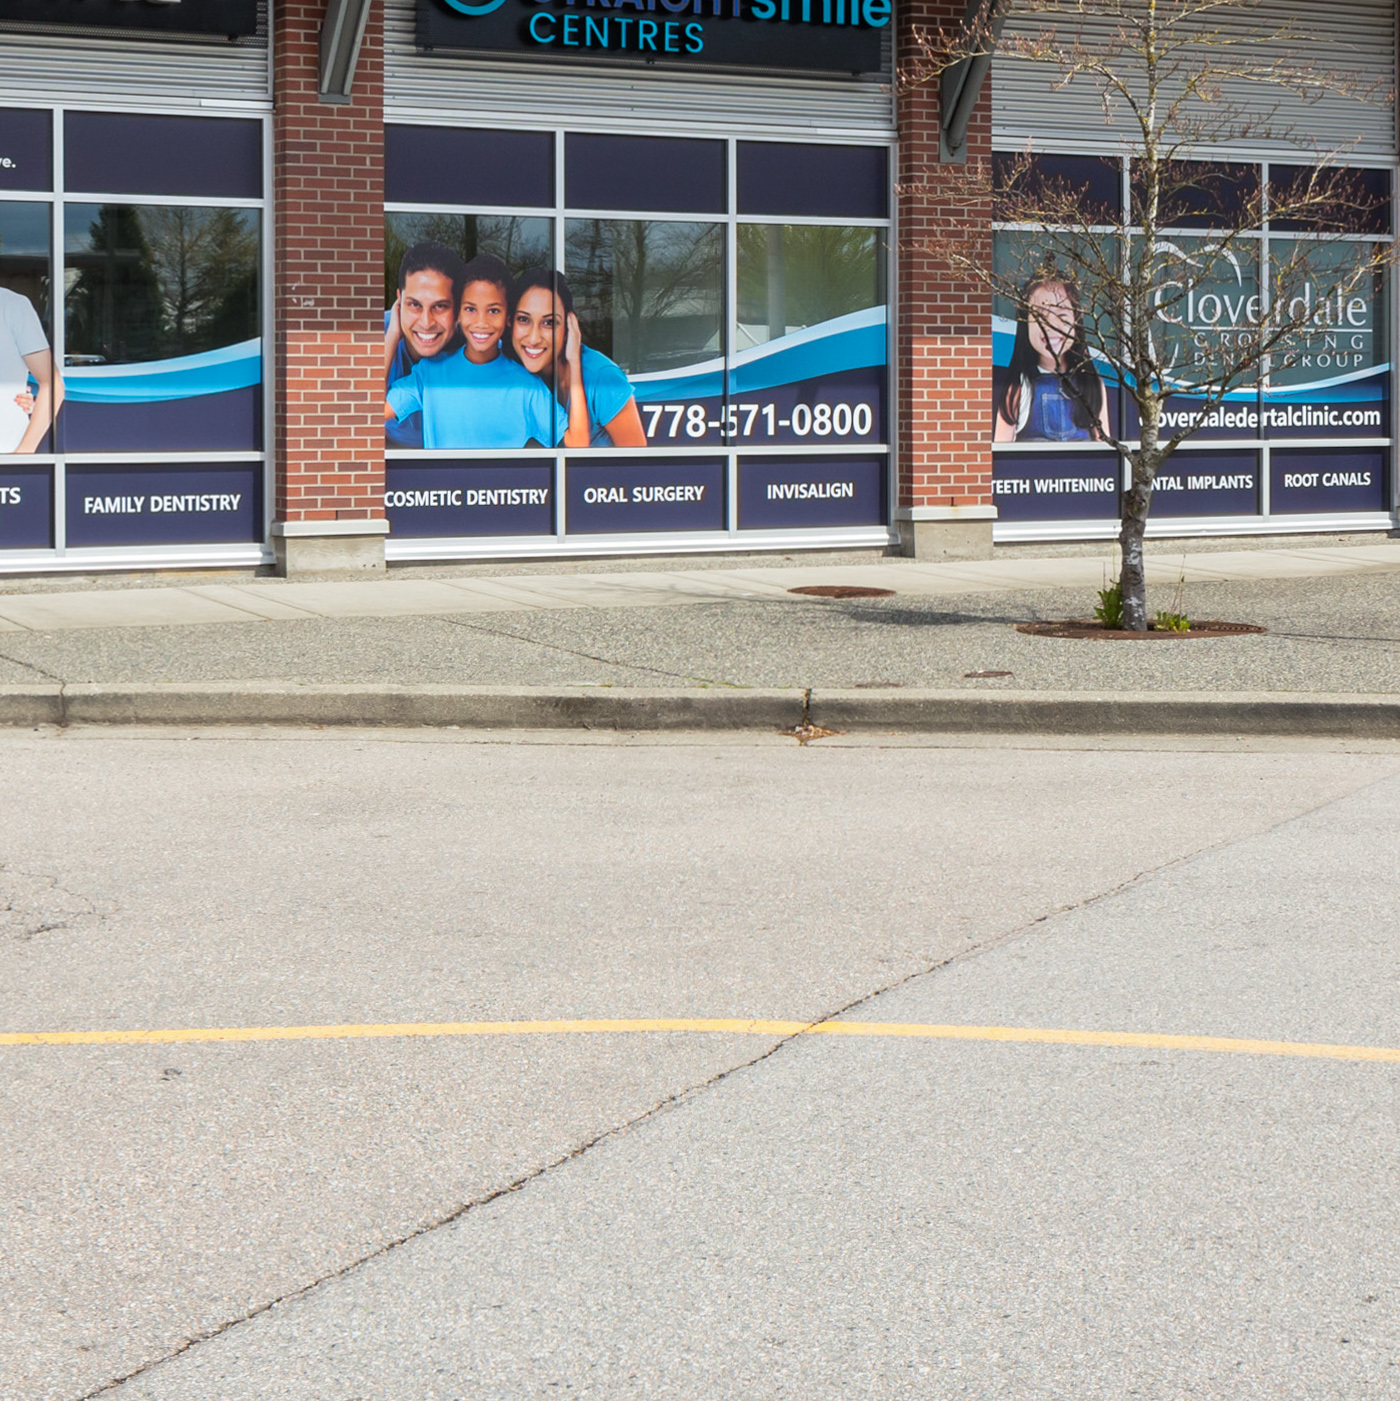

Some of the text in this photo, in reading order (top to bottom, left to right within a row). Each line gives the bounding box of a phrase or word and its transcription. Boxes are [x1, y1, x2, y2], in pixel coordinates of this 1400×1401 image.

[529, 12, 705, 54] CENTRES
[1154, 278, 1368, 326] Cloverdale
[1194, 331, 1364, 350] CROSING
[642, 403, 873, 438] 778-571-0800
[1034, 477, 1115, 493] WHITENING
[1188, 475, 1253, 490] IMPLANTS
[1284, 471, 1371, 488] ROOT CANALS
[384, 488, 548, 508] COSMETIC DENTISTRY
[584, 485, 705, 504] ORAL SURGERY
[767, 482, 854, 500] INVISALIGN
[84, 494, 241, 514] FAMILY DENTISTRY
